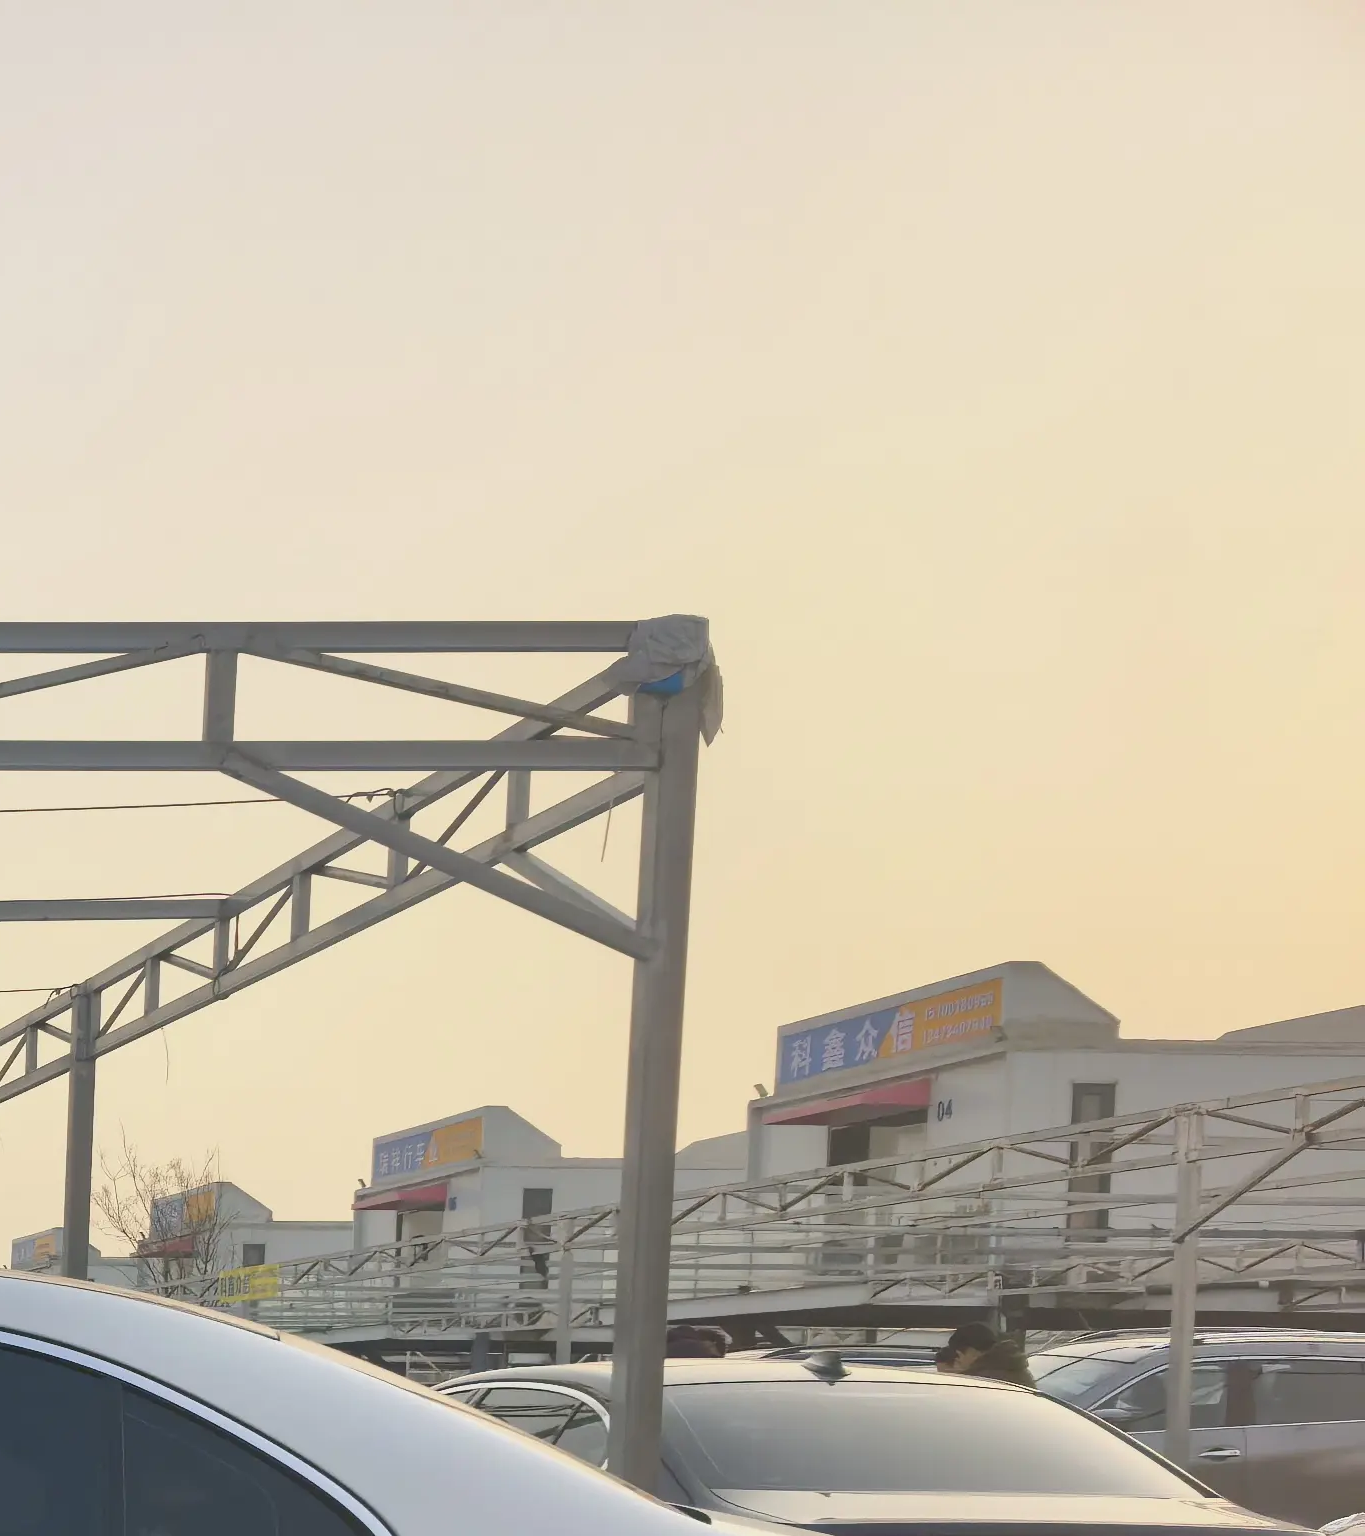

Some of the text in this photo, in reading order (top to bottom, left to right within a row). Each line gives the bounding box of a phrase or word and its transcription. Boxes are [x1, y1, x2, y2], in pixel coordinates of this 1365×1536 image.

[790, 1008, 916, 1078] 科鑫众信
[937, 1099, 953, 1121] 04
